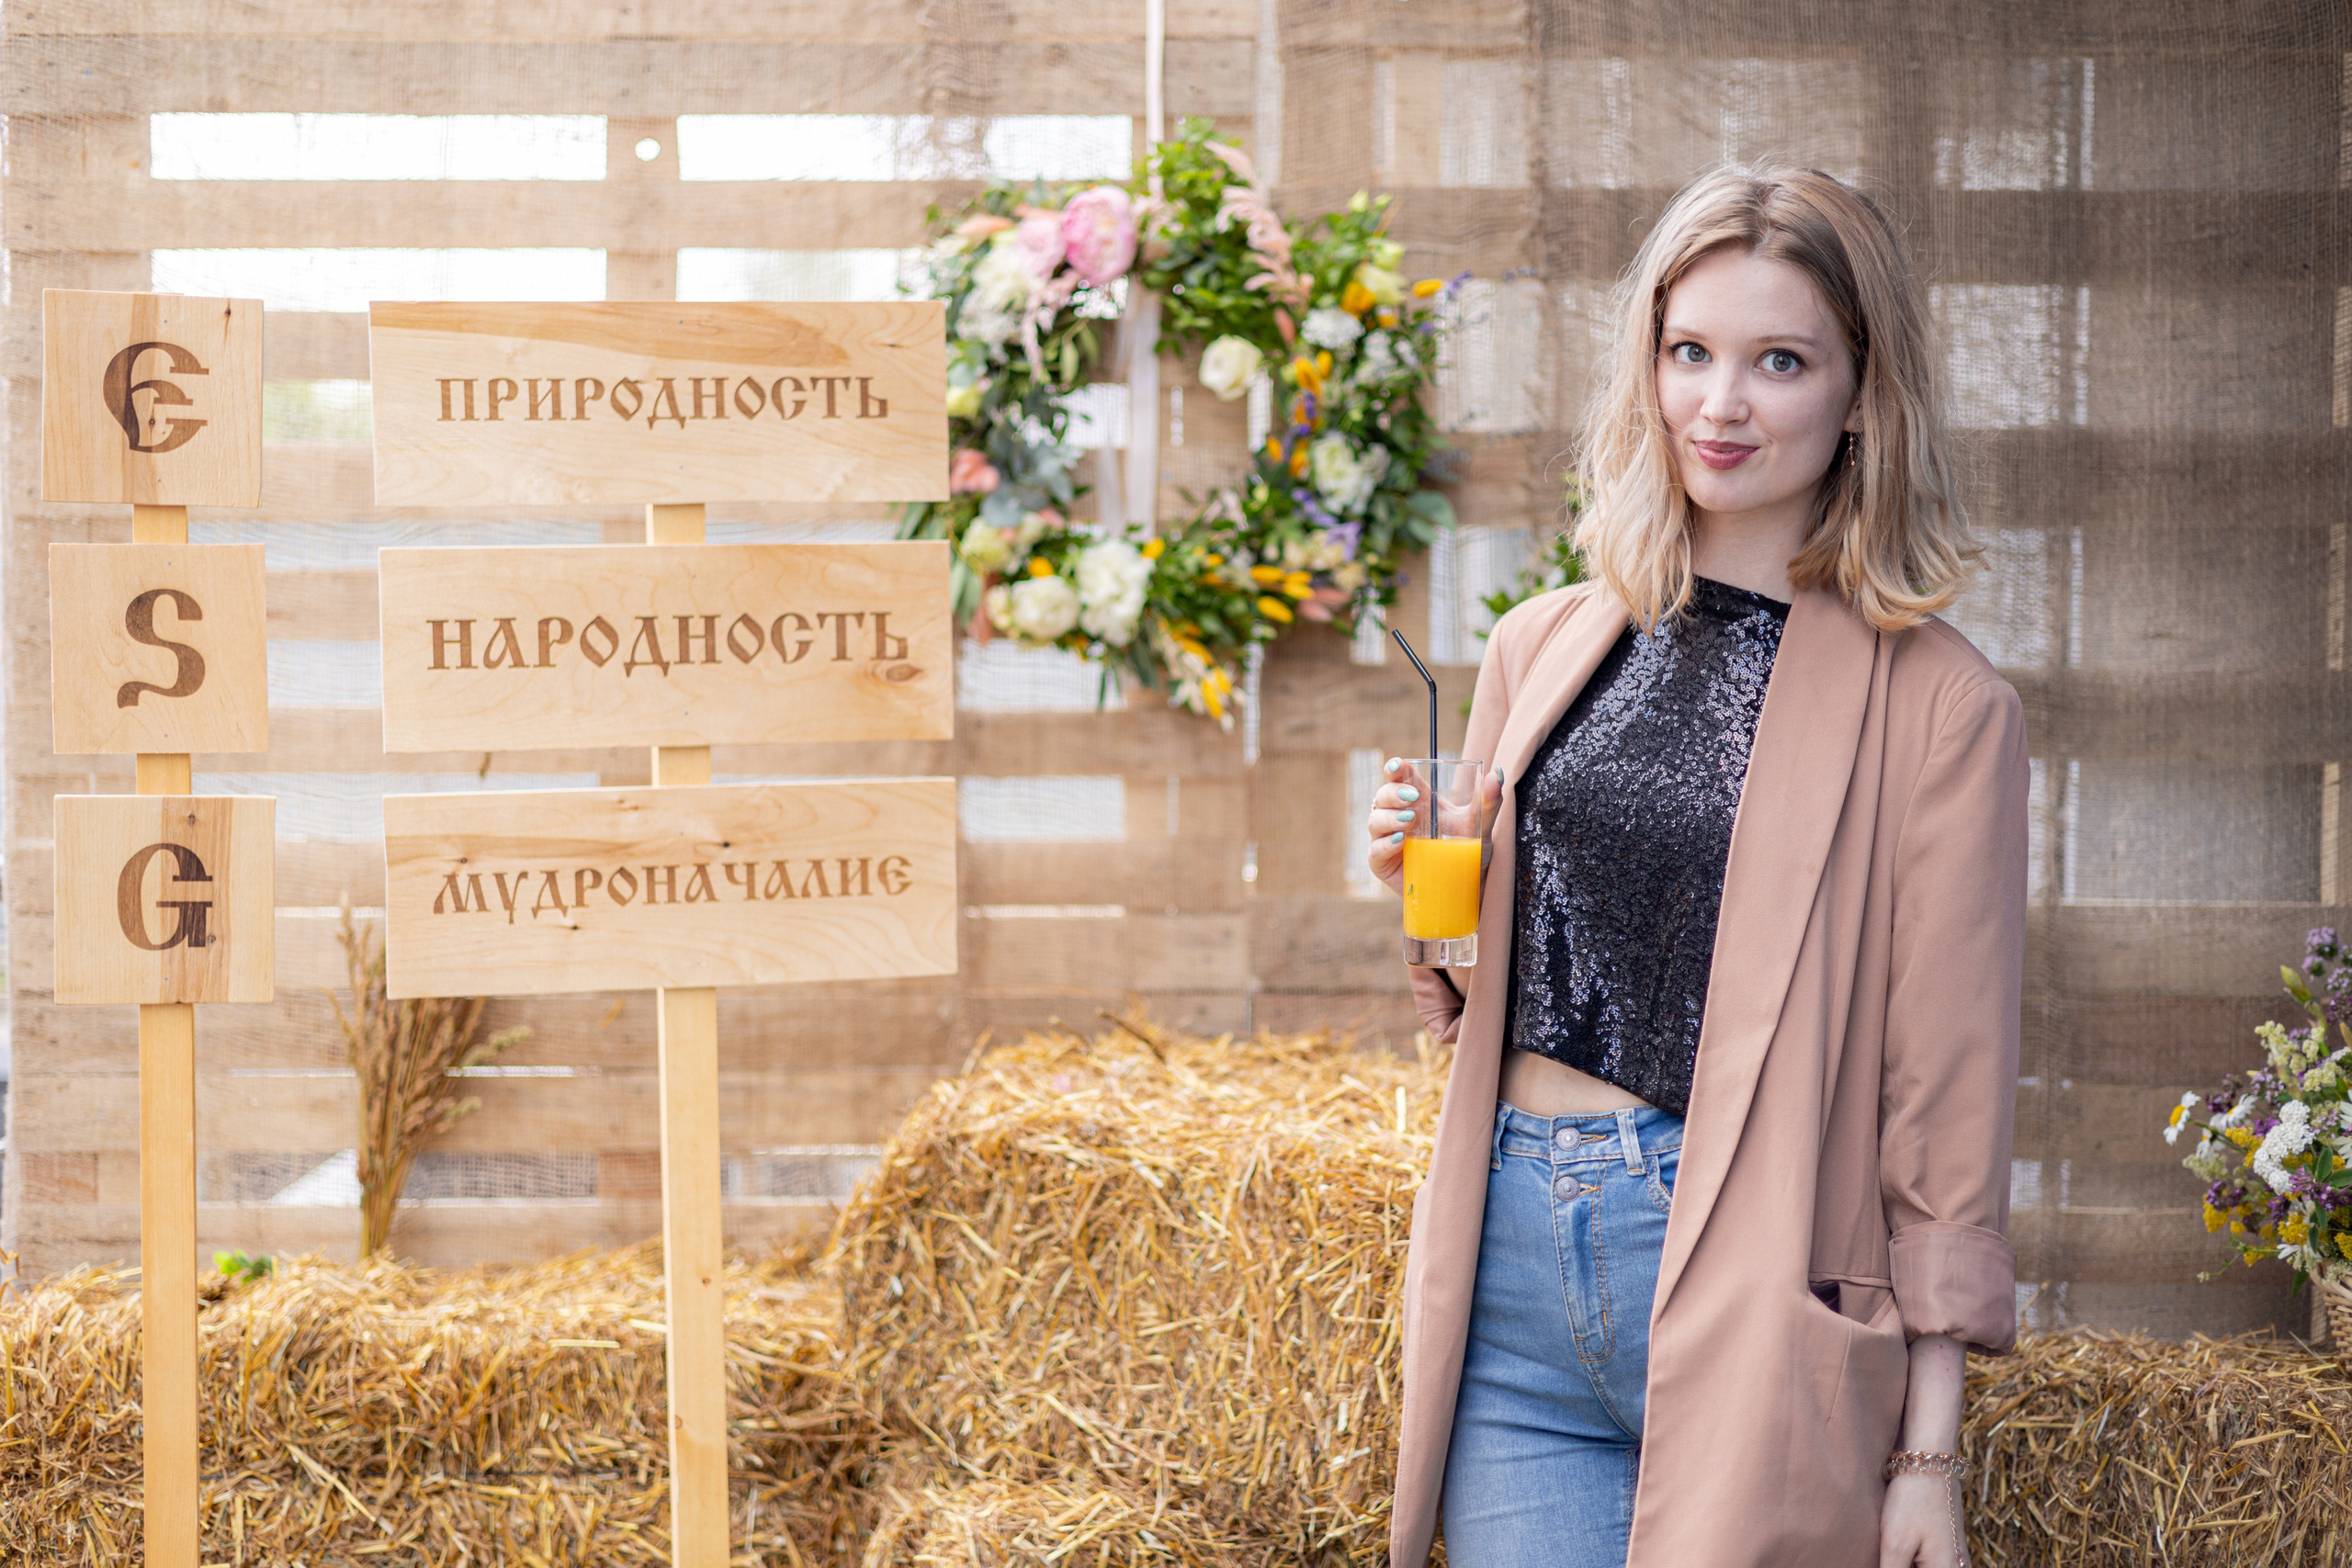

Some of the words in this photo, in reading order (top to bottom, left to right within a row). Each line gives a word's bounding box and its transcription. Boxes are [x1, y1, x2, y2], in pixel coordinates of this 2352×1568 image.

[435, 375, 889, 430] ПРИРОДНОСТЬ
[117, 588, 207, 709] S
[425, 612, 909, 678] НАРОДНОСТЬ
[117, 842, 213, 951] G
